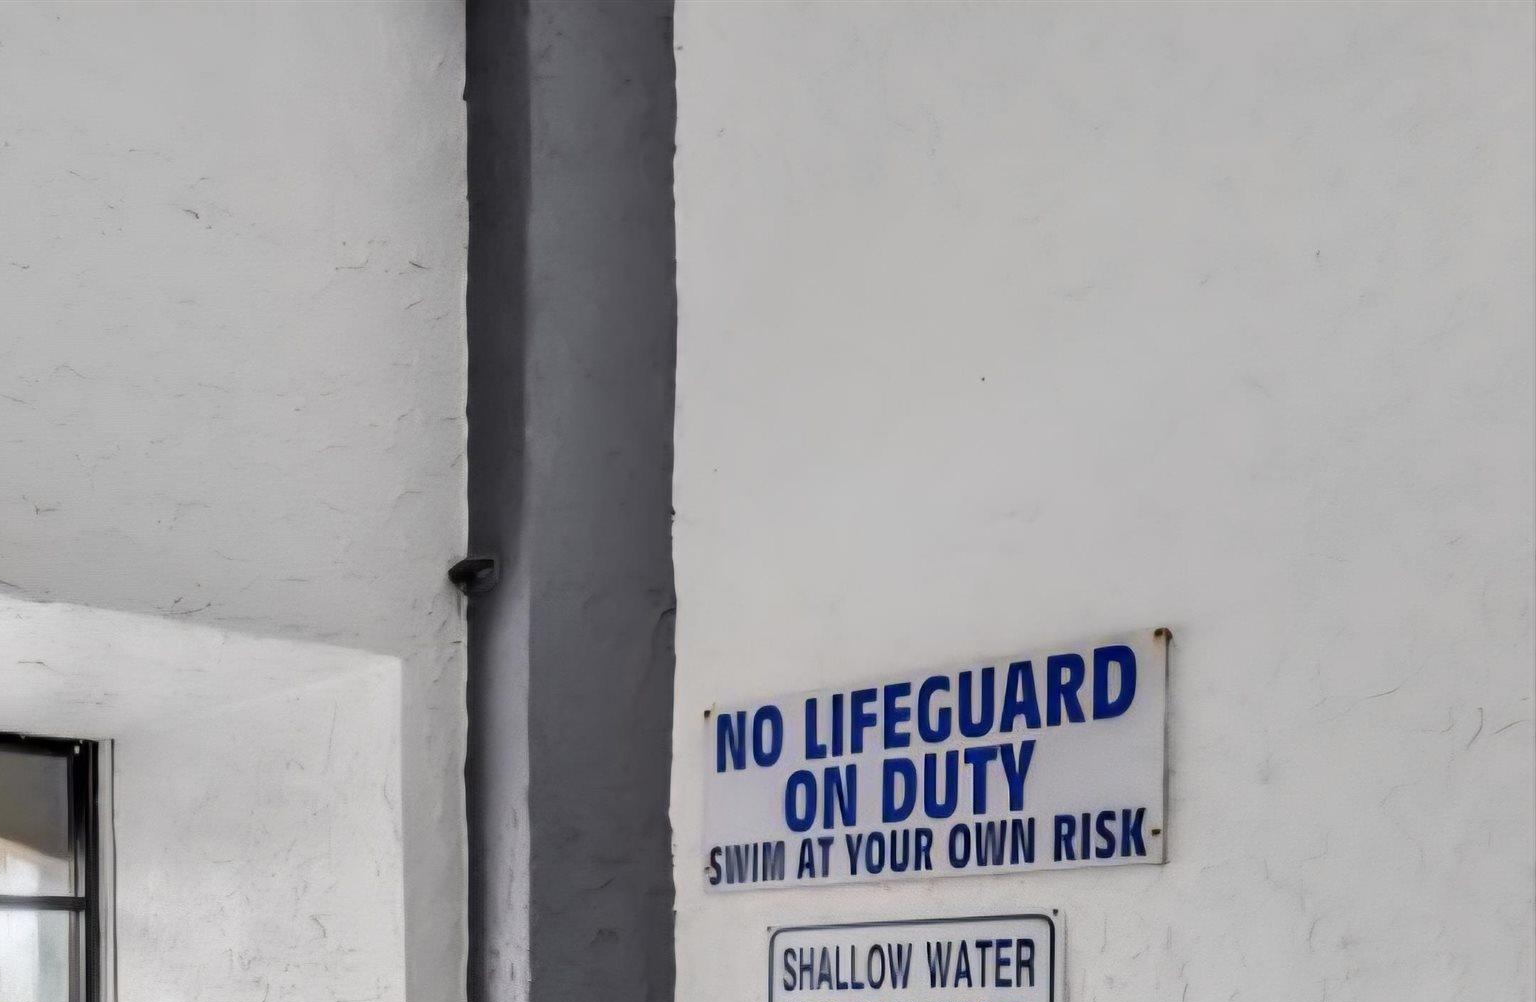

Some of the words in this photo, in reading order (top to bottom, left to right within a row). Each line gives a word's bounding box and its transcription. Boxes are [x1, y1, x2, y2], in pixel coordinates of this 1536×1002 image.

[716, 705, 783, 772] NO
[805, 645, 1137, 759] LIFEGUARD
[784, 764, 857, 832] ON
[882, 740, 1036, 823] DUTY
[709, 840, 785, 885] SWIM
[797, 836, 834, 879] AT
[845, 827, 933, 875] YOUR
[949, 817, 1035, 868] OWN
[1053, 807, 1147, 862] RISK
[783, 943, 912, 991] SHALLOW
[927, 938, 1034, 988] WATER
